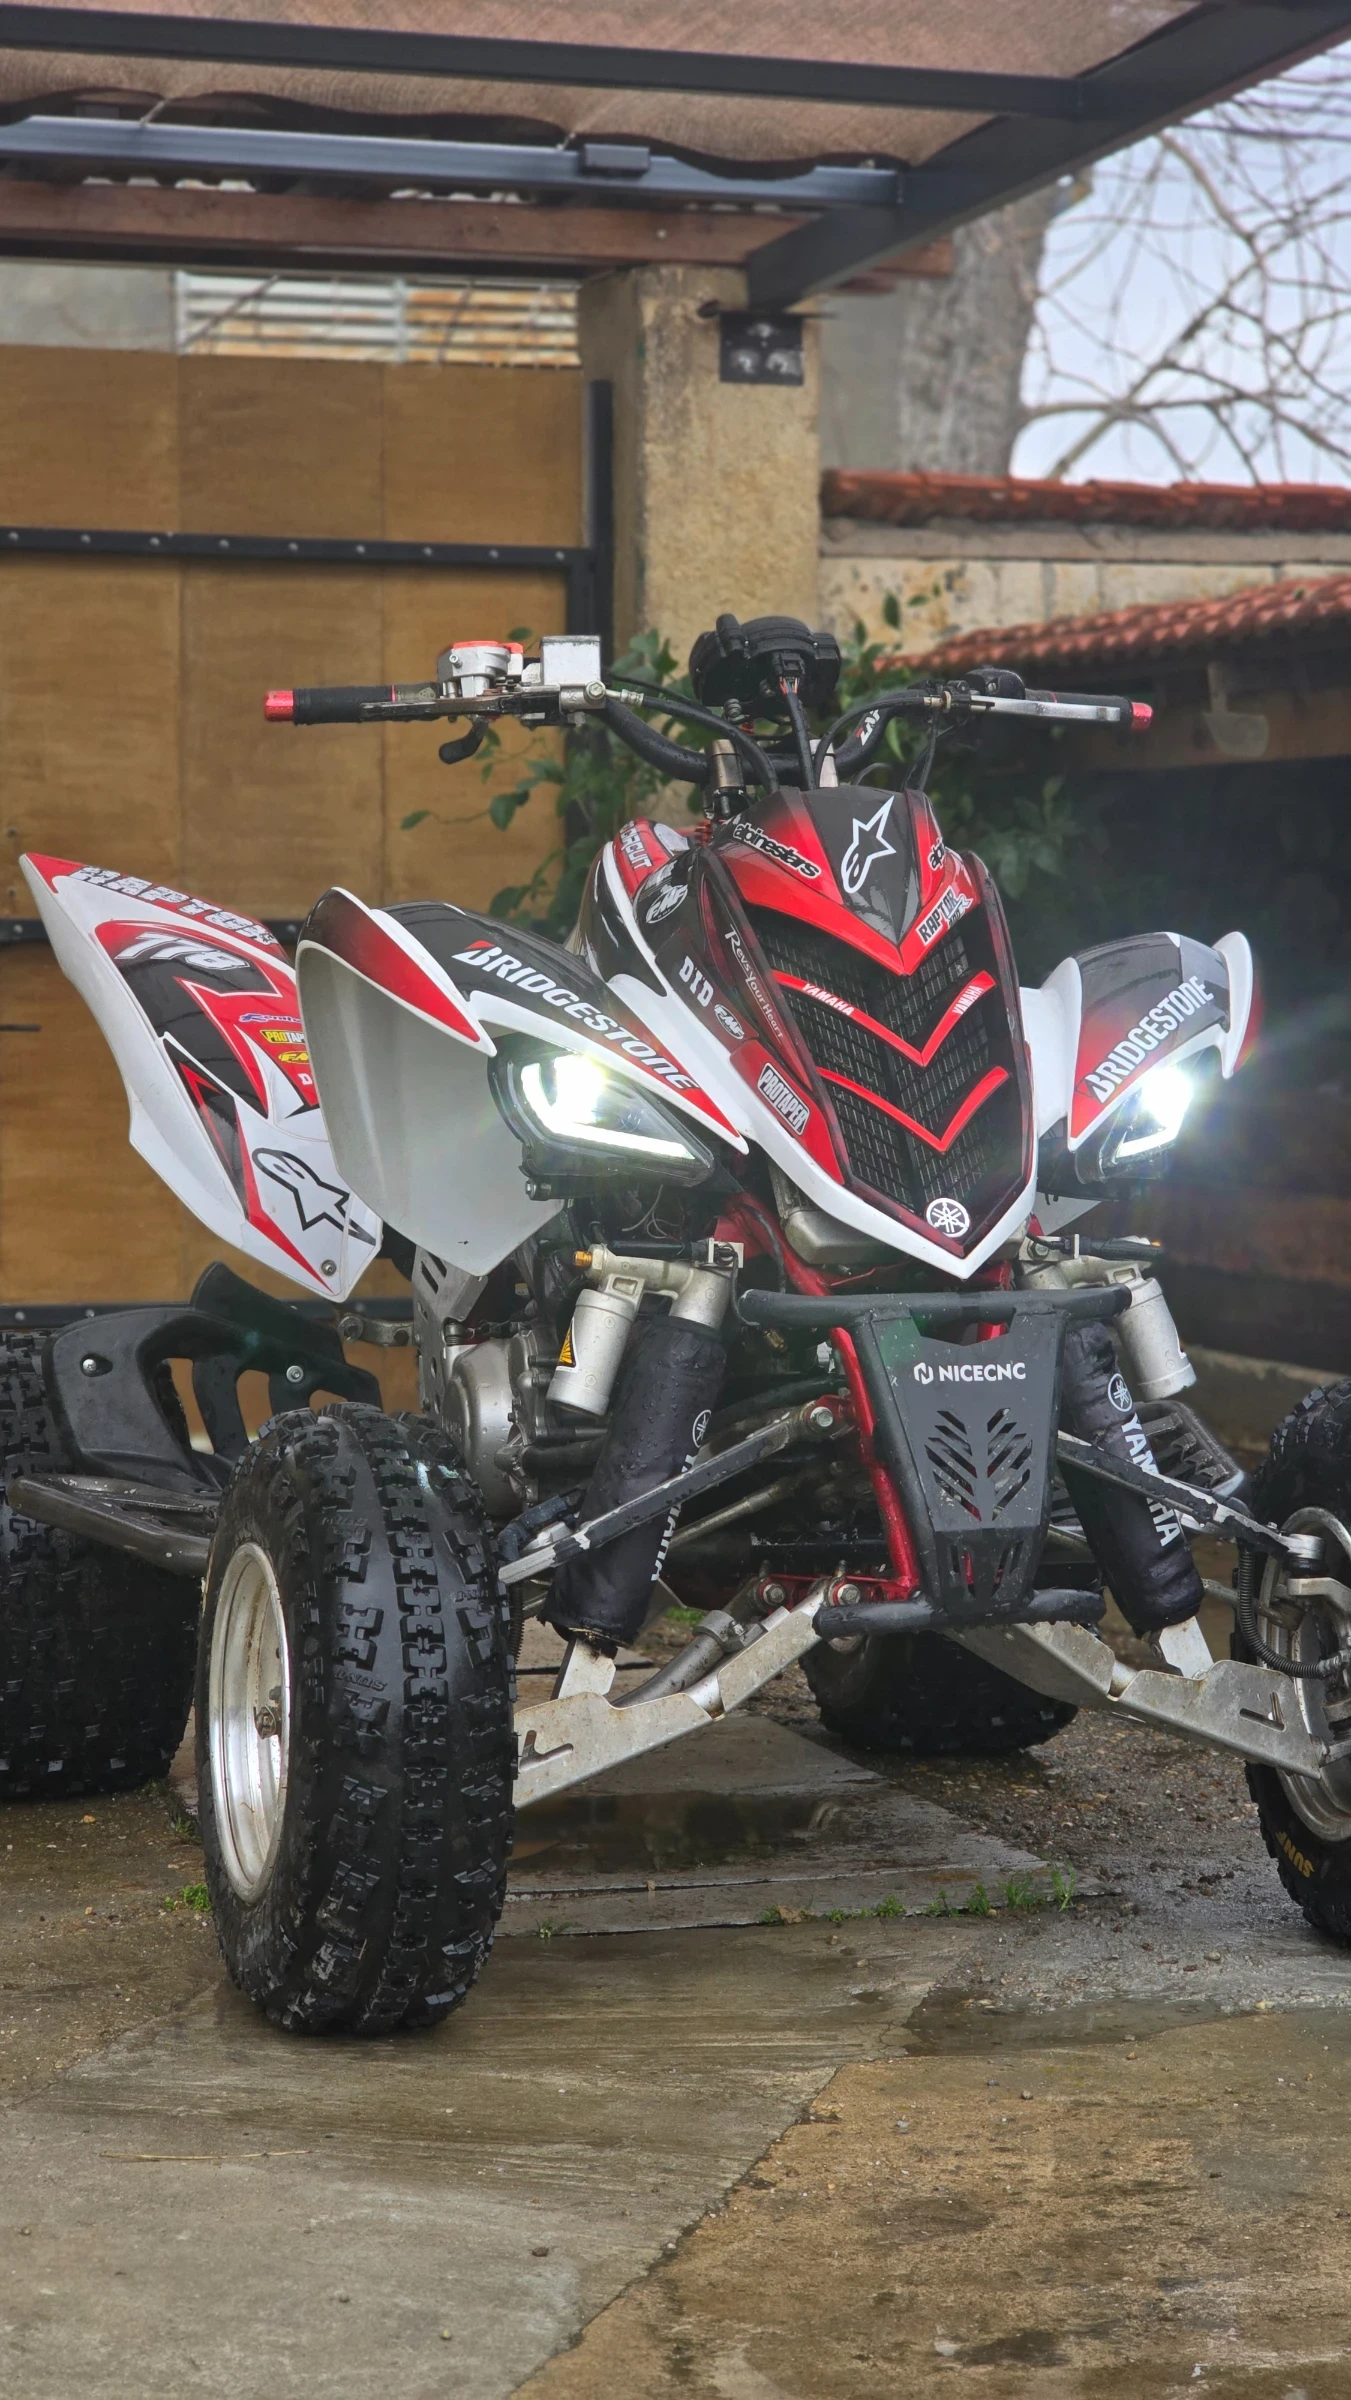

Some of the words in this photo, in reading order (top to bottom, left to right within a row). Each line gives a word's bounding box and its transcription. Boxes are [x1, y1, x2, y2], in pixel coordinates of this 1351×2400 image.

[733, 822, 821, 879] alpinestars
[69, 865, 280, 947] RAPTOR
[917, 888, 958, 944] RAPTOR
[114, 932, 249, 972] 778
[451, 944, 701, 1091] BRIDGESTONE
[714, 1005, 745, 1038] FMF
[802, 982, 855, 1016] YAMAHA
[951, 984, 985, 1016] YAMAHA
[1084, 975, 1215, 1104] BRIDGESTONE
[759, 1068, 809, 1134] PROTAPER
[939, 1362, 1027, 1383] NICECNC
